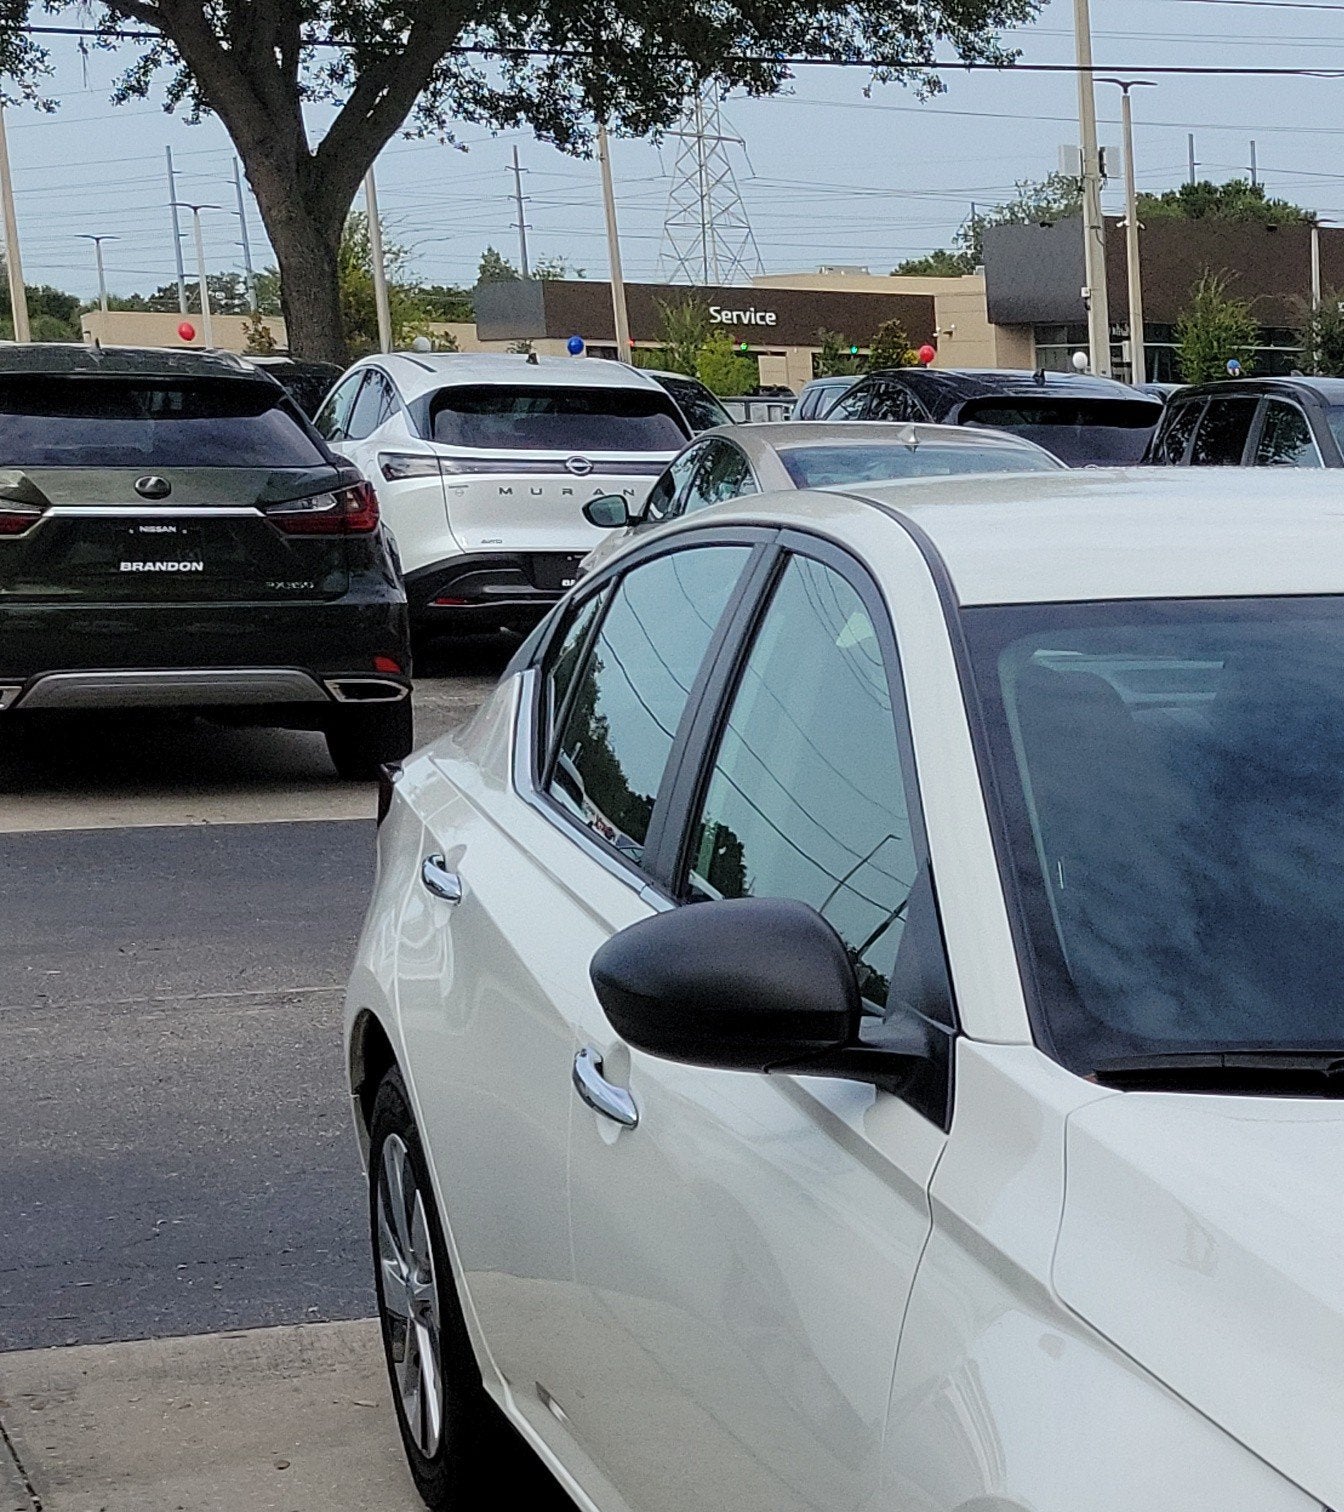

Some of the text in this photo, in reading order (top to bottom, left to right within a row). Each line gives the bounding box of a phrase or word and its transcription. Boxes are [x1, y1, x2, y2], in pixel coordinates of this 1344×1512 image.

[709, 306, 777, 326] Service
[499, 486, 635, 496] MURAN
[139, 525, 177, 533] NISSAN
[119, 561, 204, 572] BRANDON
